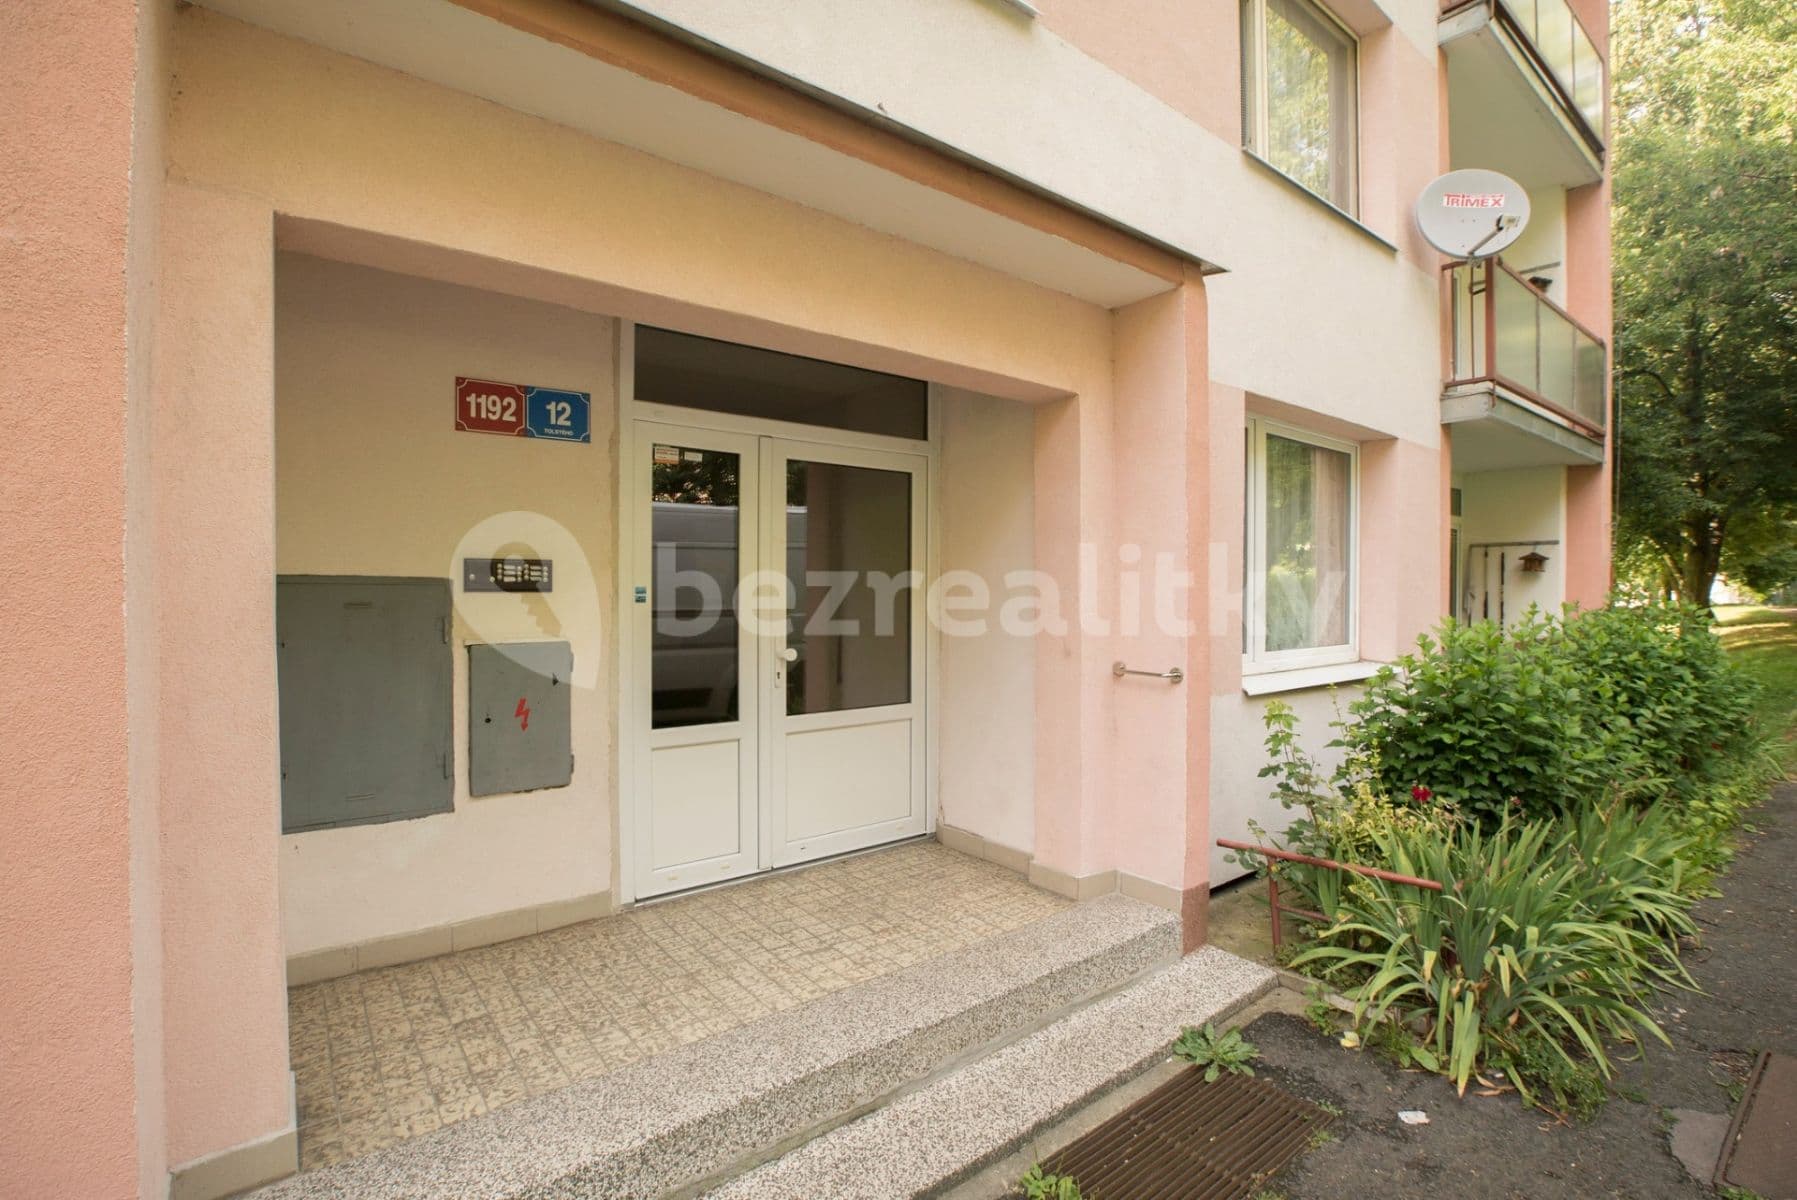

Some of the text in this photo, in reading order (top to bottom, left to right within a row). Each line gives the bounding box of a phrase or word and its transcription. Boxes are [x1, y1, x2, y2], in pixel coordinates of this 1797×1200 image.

[1444, 193, 1504, 207] TRIMEX
[466, 393, 517, 423] 1192
[545, 401, 572, 427] 12
